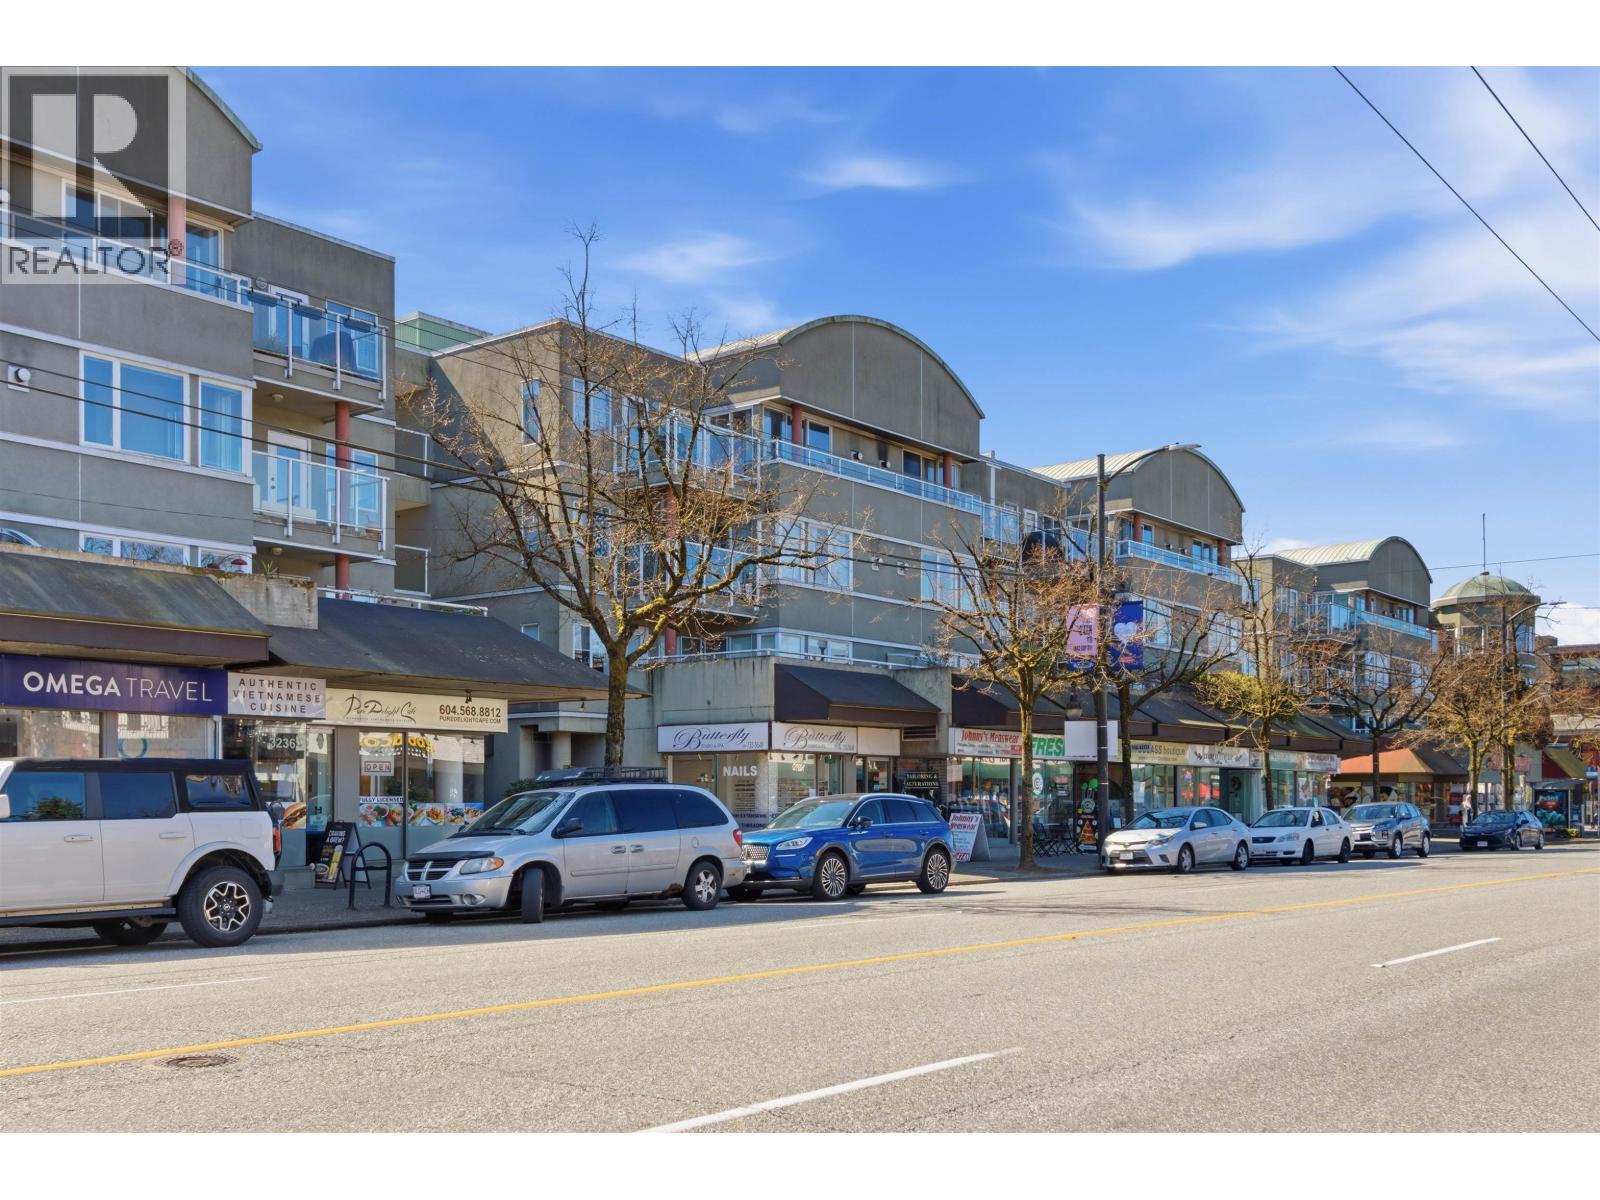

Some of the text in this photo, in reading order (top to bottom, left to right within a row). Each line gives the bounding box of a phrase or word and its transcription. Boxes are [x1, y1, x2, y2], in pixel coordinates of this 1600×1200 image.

[23, 671, 213, 702] OMEGA TRAVEL
[239, 678, 317, 690] AUTHENTIC
[233, 690, 321, 702] VIETNAMESE
[250, 702, 307, 713] CUISINE
[439, 704, 501, 718] 604.568.8812
[269, 738, 296, 749] 3236
[673, 727, 750, 750] Butterfly
[783, 726, 847, 749] Butterfly
[960, 730, 1020, 744] Johnny's Menswear
[1032, 736, 1065, 756] FRES
[366, 763, 392, 771] OPEN
[722, 765, 758, 777] NAILS
